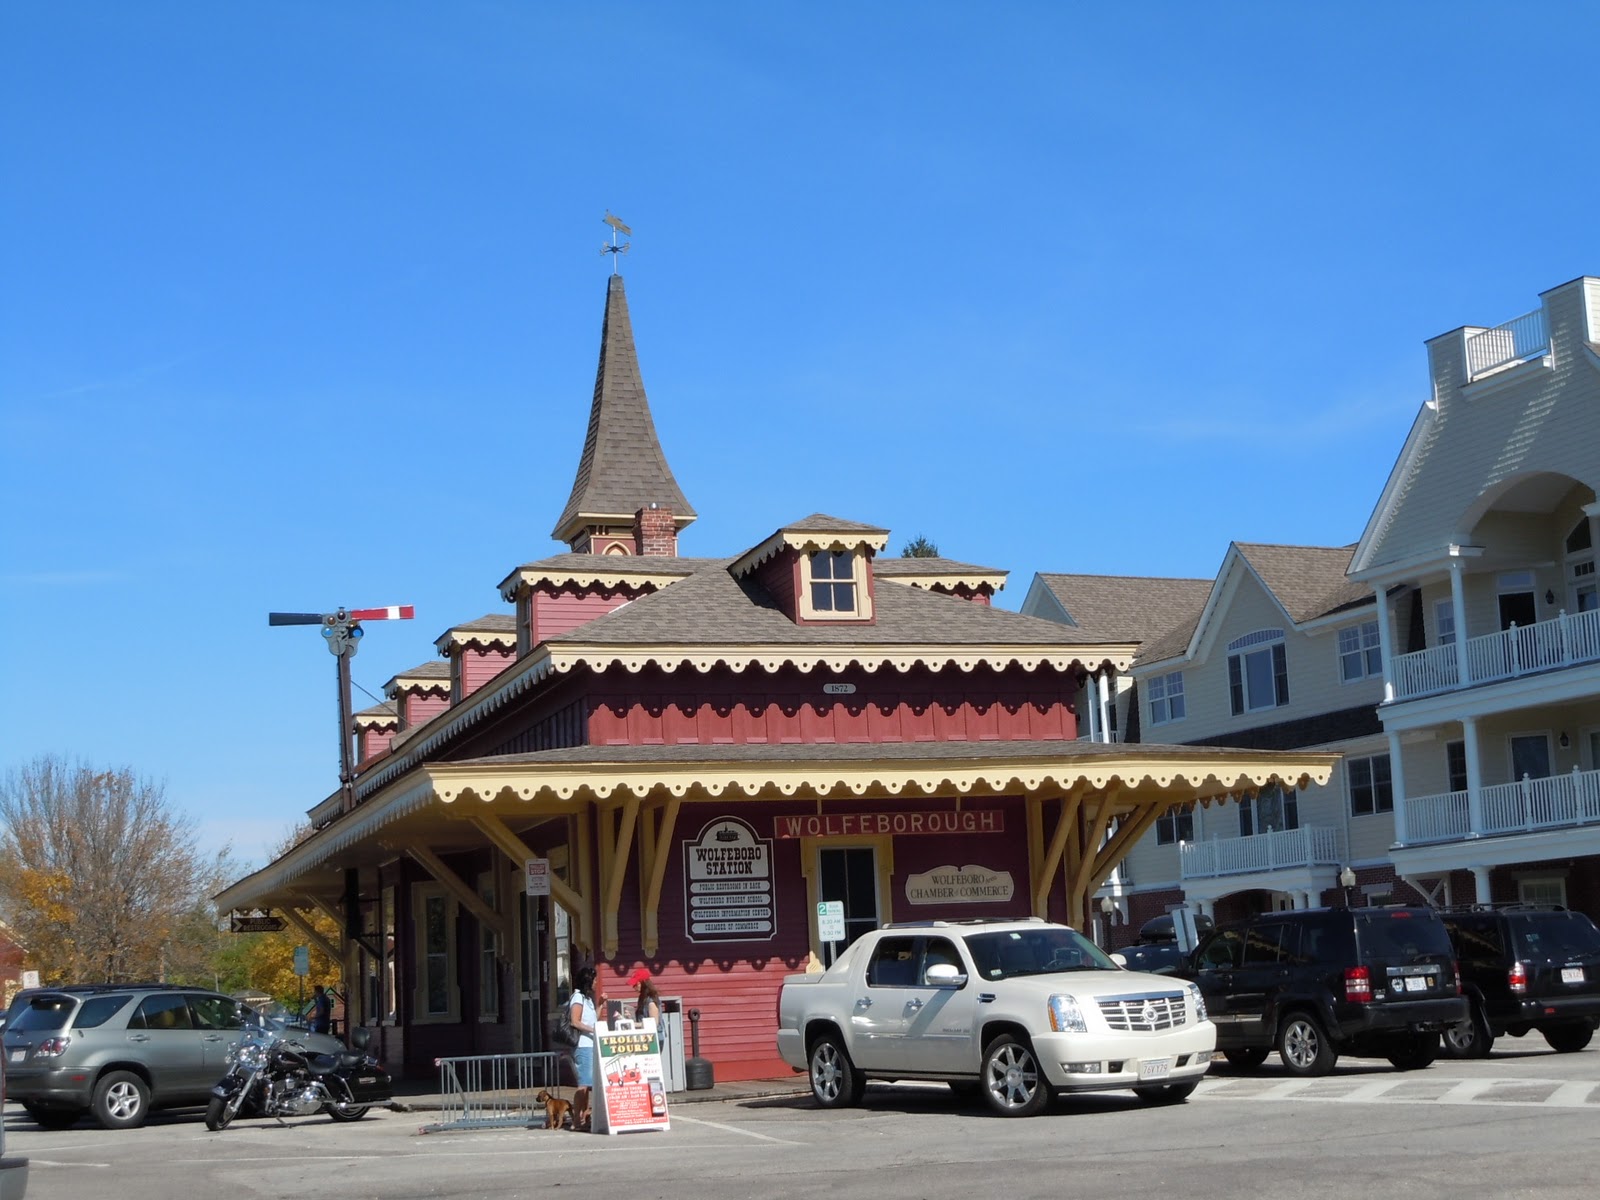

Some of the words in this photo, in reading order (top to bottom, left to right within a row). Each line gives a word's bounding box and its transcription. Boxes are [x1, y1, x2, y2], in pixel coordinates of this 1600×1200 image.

[831, 684, 849, 692] 1872
[785, 812, 994, 836] WOLFEBOROUGH
[695, 847, 762, 862] WOLFEBORO
[706, 861, 753, 875] STATION
[931, 874, 985, 885] WOLFEBORO
[699, 883, 715, 891] PUBLIC
[910, 888, 954, 899] CHAMBER
[960, 885, 1009, 897] COMMERCE
[698, 897, 725, 905] WOLFEBORO
[726, 896, 746, 904] NURSERY
[693, 910, 720, 918] WOLFEBORO
[819, 904, 826, 914] 2
[705, 923, 726, 931] CHAMBER
[735, 922, 759, 930] COMMERCE
[601, 1034, 655, 1046] TROLLEY
[609, 1044, 650, 1054] TOURS
